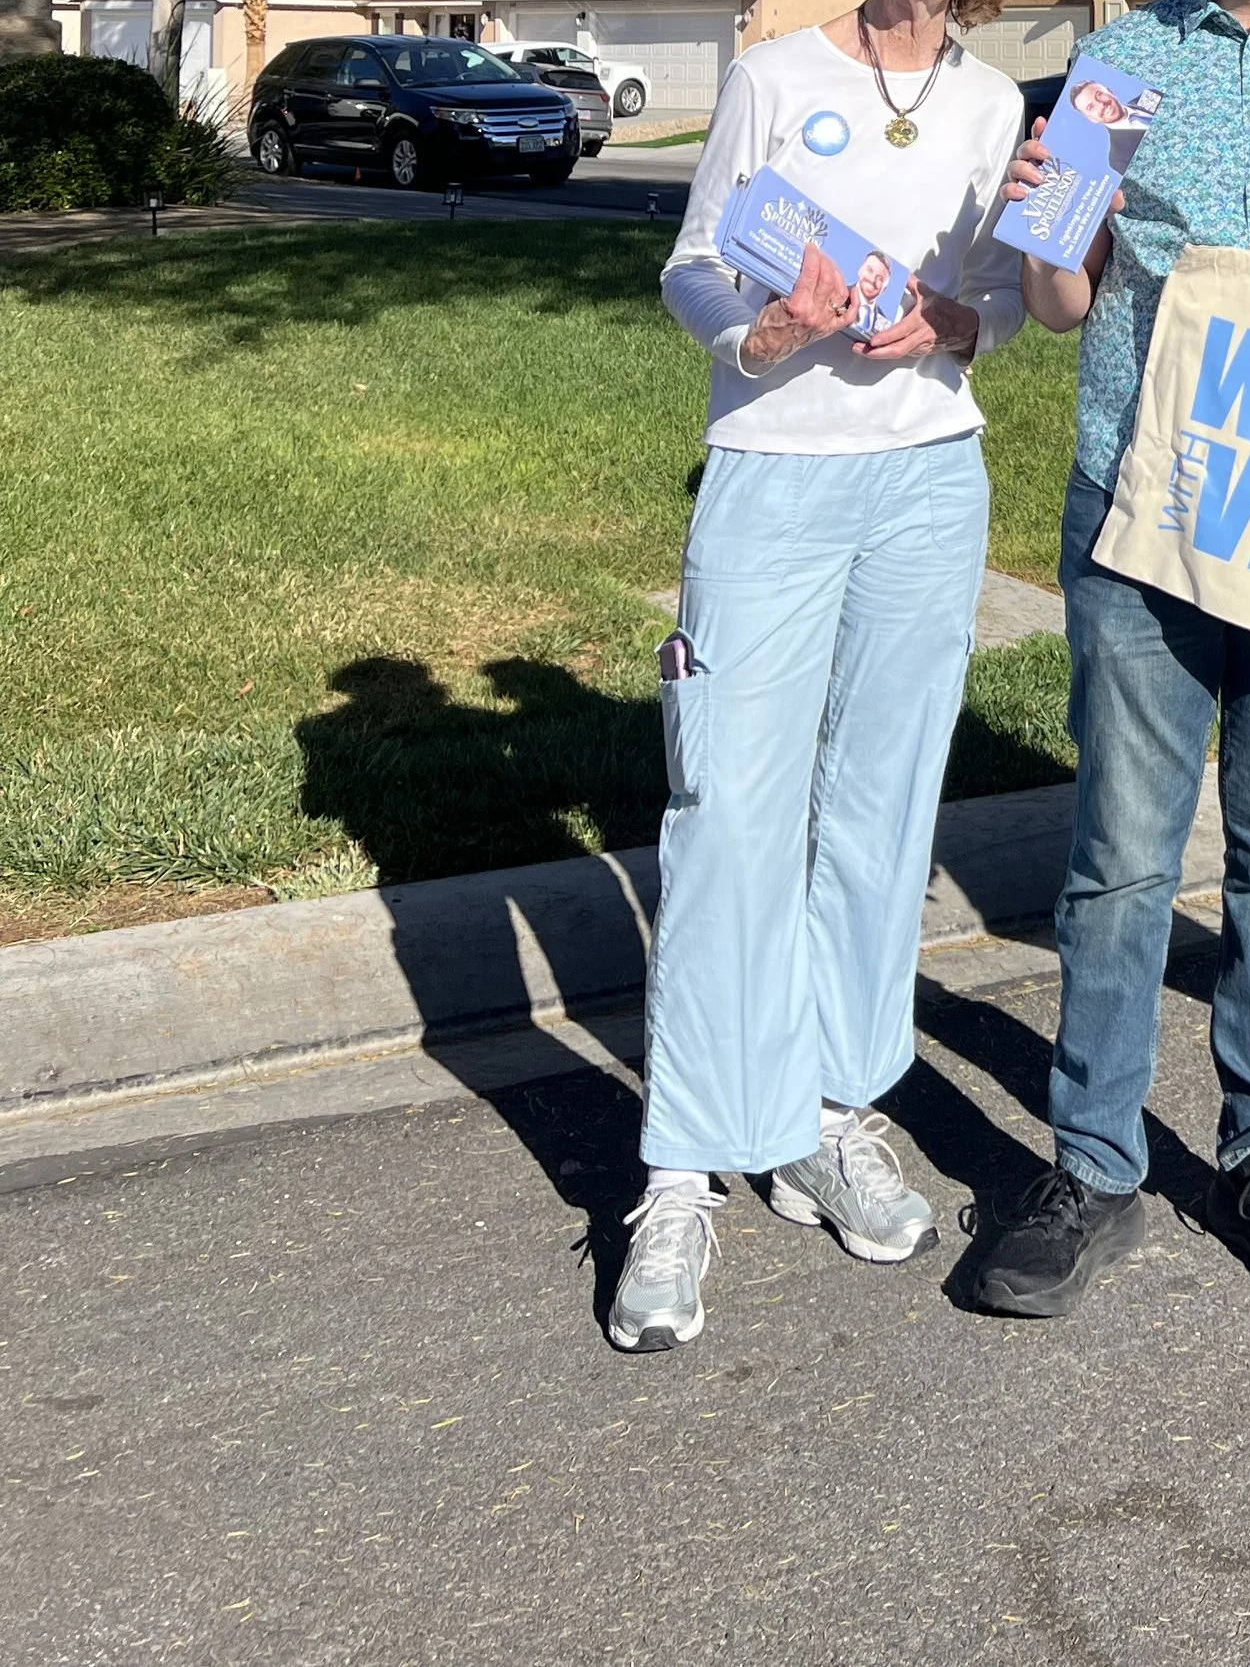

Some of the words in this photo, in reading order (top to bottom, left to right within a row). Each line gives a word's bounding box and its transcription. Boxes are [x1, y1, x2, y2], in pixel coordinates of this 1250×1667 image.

[779, 196, 820, 236] VINNY
[1021, 168, 1061, 219] VINNY
[1030, 167, 1077, 241] SPOTLESON
[1059, 214, 1080, 246] Fighting
[1075, 202, 1085, 214] For
[1082, 186, 1093, 200] You
[1063, 244, 1074, 259] The
[1070, 225, 1084, 244] Land
[1080, 212, 1090, 225] We
[1087, 195, 1098, 212] Call
[1095, 174, 1110, 197] Home
[1157, 430, 1209, 532] WITH
